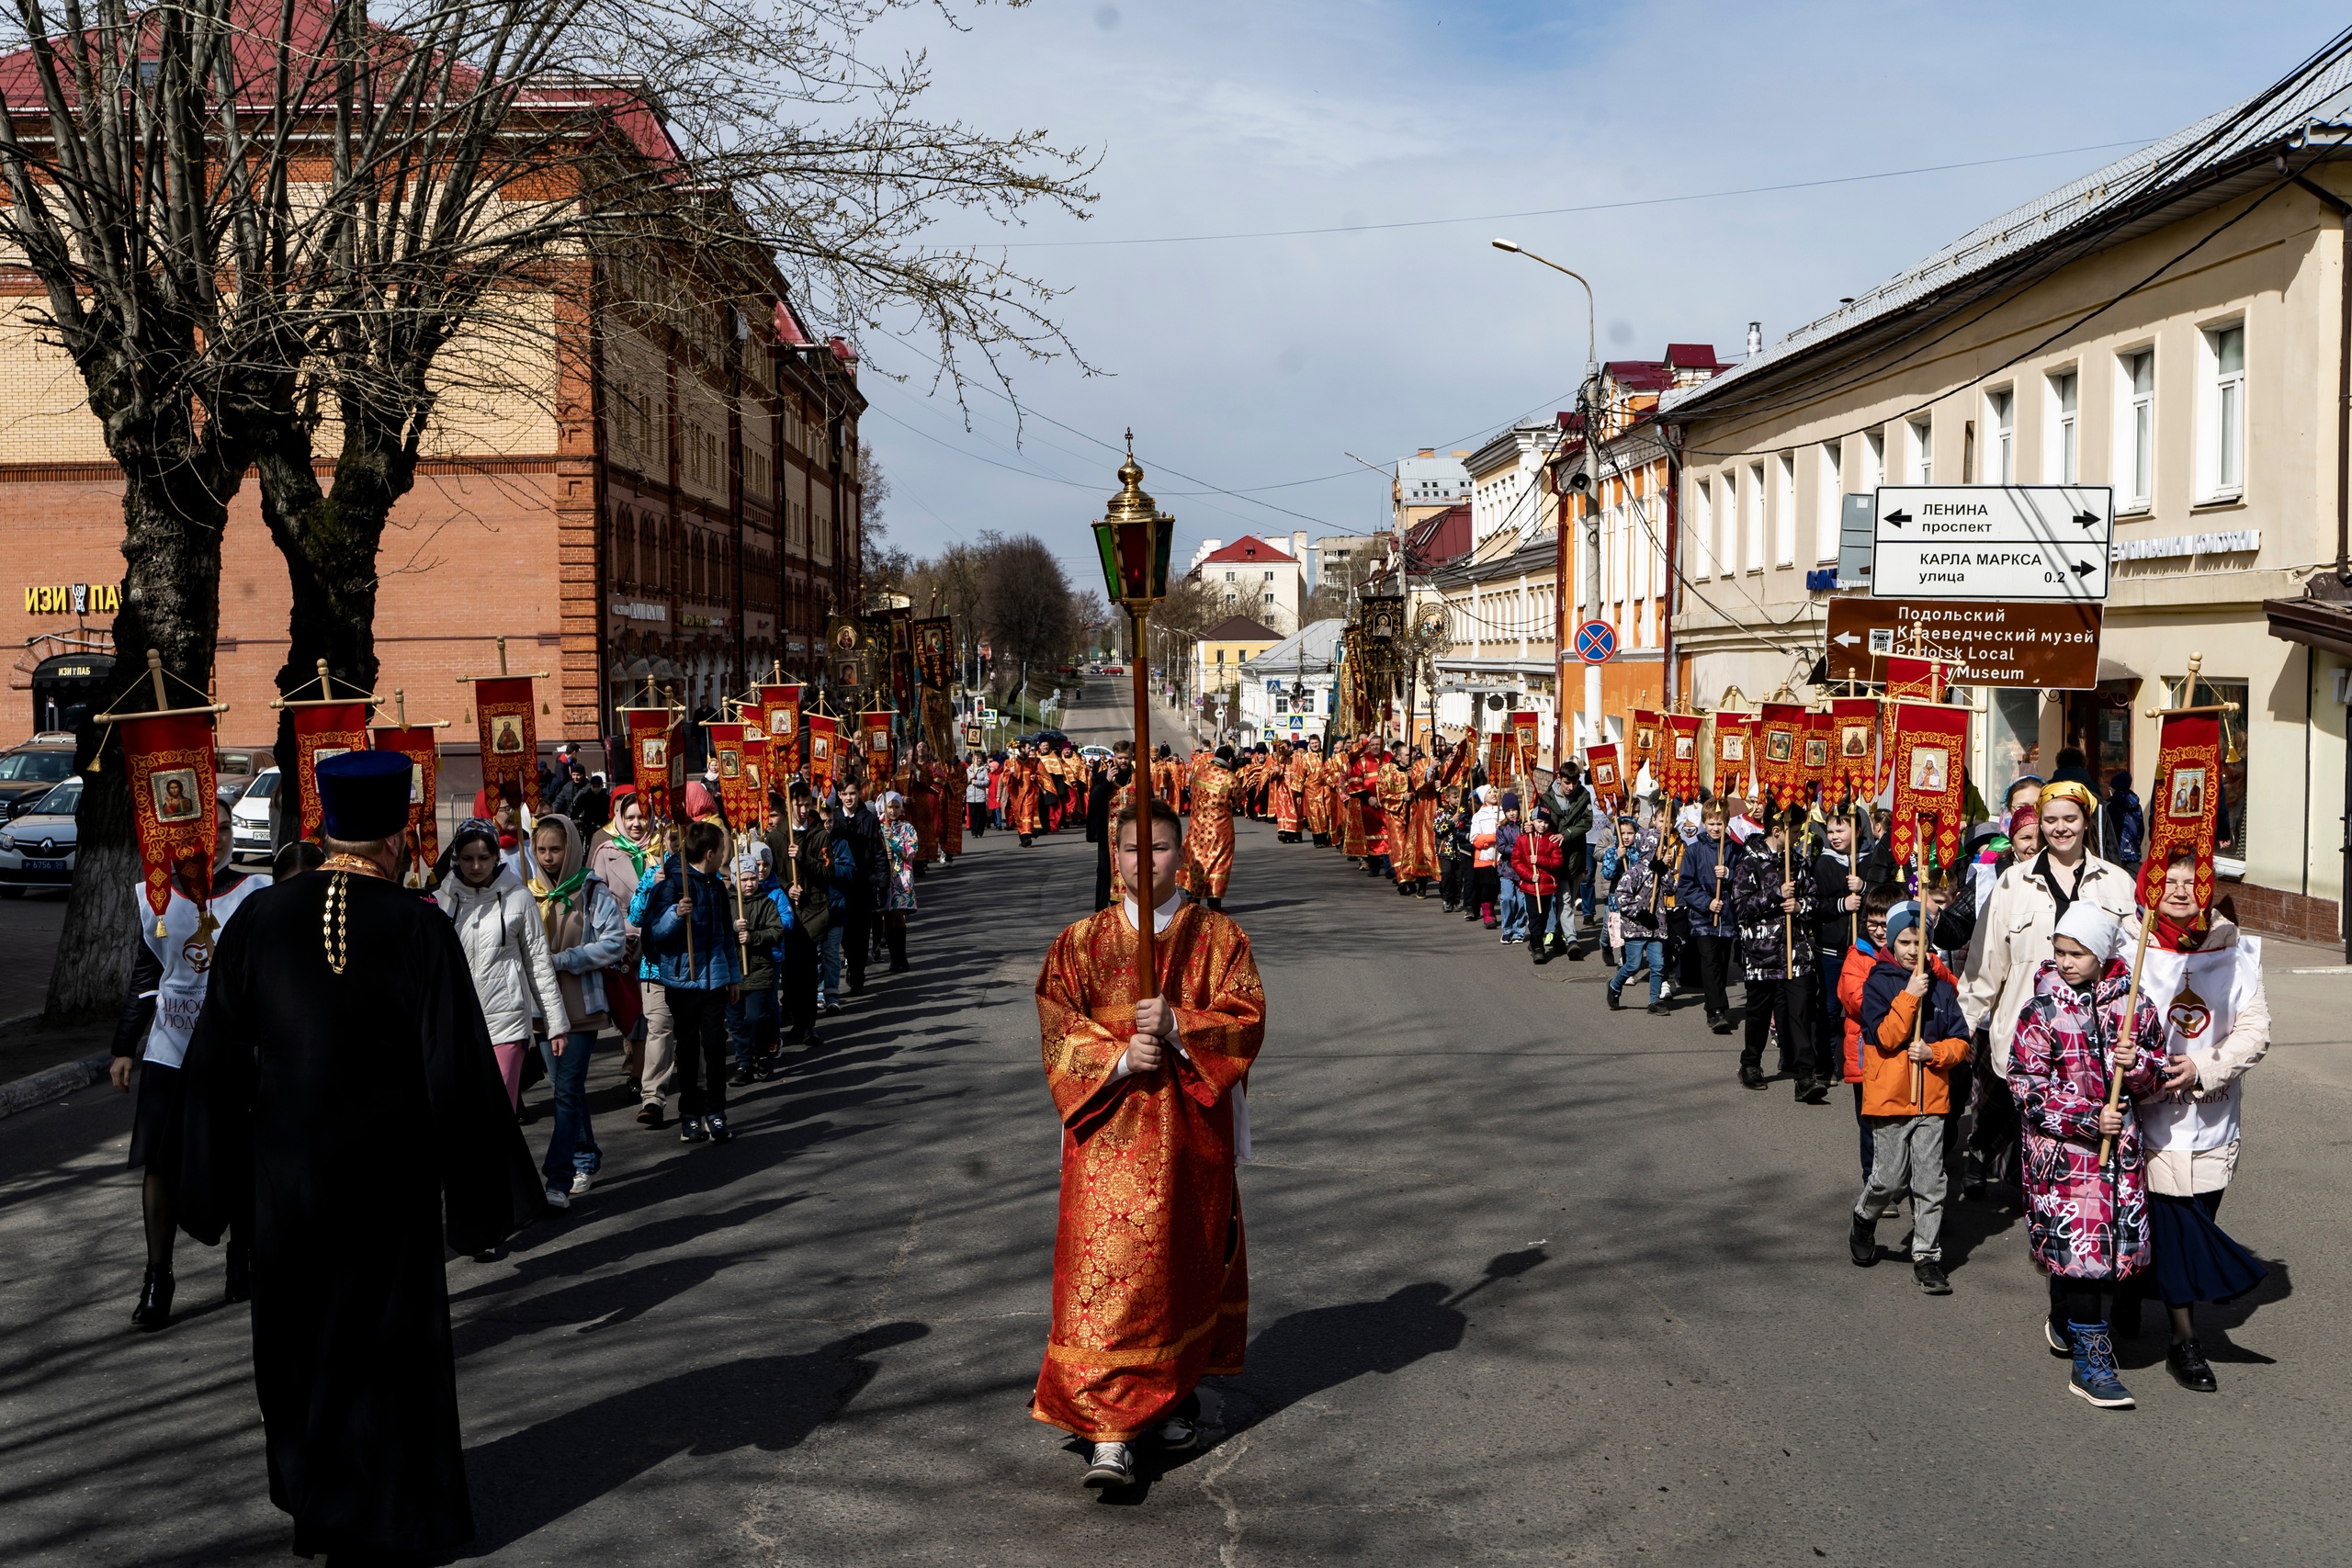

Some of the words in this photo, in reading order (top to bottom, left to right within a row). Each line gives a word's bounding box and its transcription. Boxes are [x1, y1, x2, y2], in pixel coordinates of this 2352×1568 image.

[1922, 503, 1988, 515] ЛЕНИНА
[1922, 523, 1992, 533] проспект
[1920, 553, 1971, 565] КАРЛА
[1976, 554, 2041, 566] МАРКСА
[1919, 572, 1964, 584] улица
[2044, 571, 2065, 583] 0.2
[25, 585, 67, 613] ИЗИ
[91, 584, 122, 611] ПА
[1898, 606, 2005, 623] Подольский
[2041, 629, 2094, 645] музей
[1968, 647, 2015, 660] Local
[58, 668, 72, 676] ИЗИ
[77, 667, 90, 676] ПАБ
[1957, 665, 2024, 680] Museum
[32, 861, 51, 869] 6756
